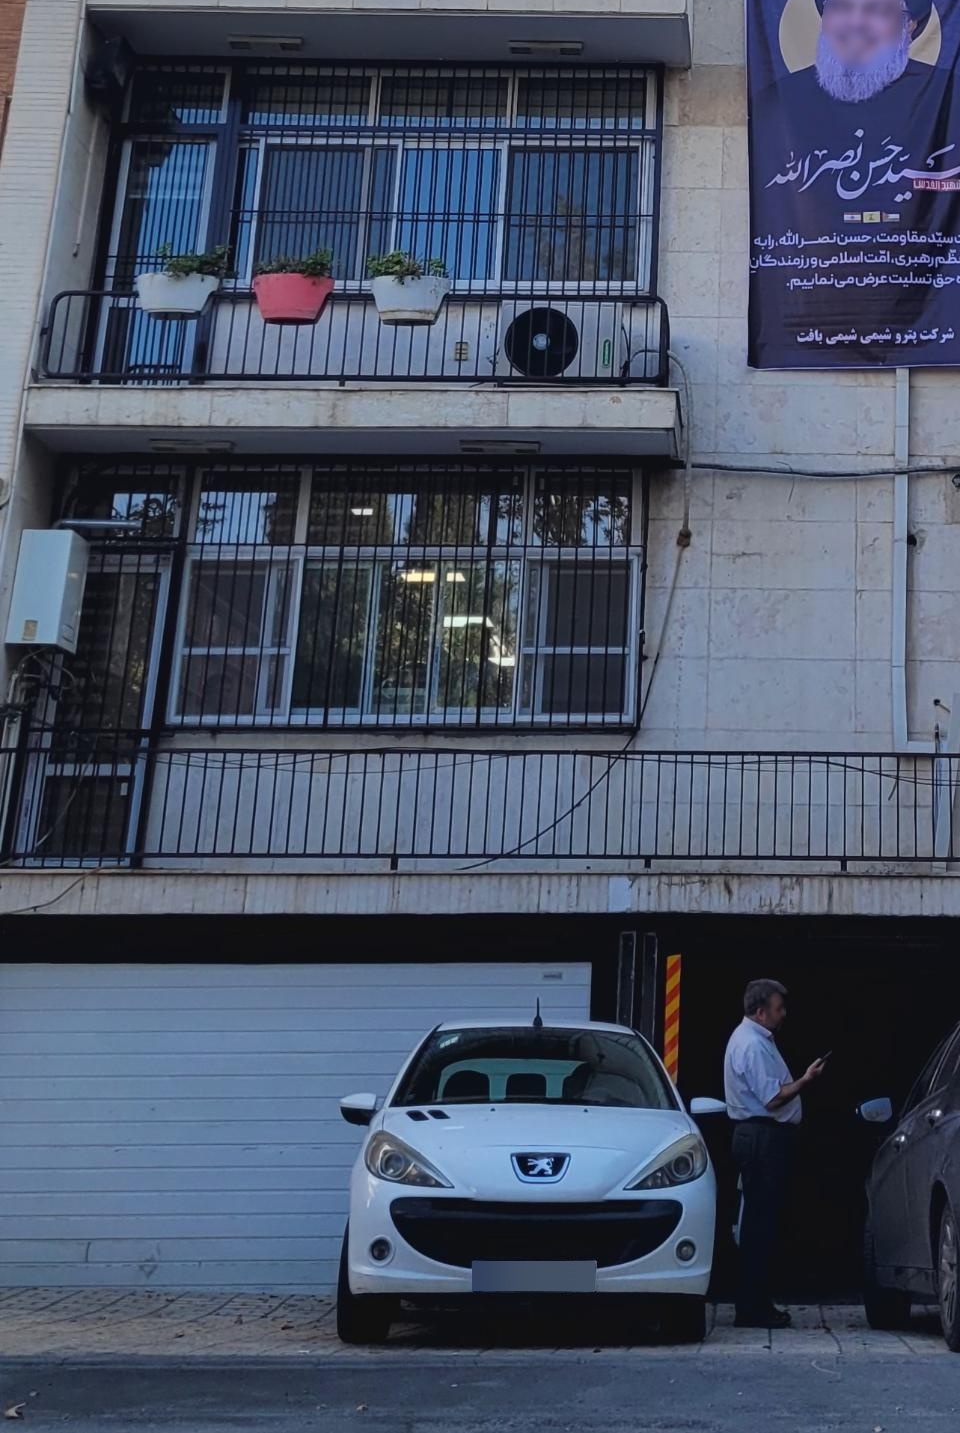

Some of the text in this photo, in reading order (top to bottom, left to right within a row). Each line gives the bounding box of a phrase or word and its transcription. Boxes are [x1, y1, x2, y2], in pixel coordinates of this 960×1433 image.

[836, 233, 872, 246] حسن
[818, 251, 863, 268] اسلامی
[856, 273, 887, 288] عرض
[888, 272, 932, 288] تسلیت
[933, 274, 955, 288] حق
[796, 329, 823, 344] بافت
[826, 329, 858, 345] شیمی
[919, 328, 955, 344] شرکت
